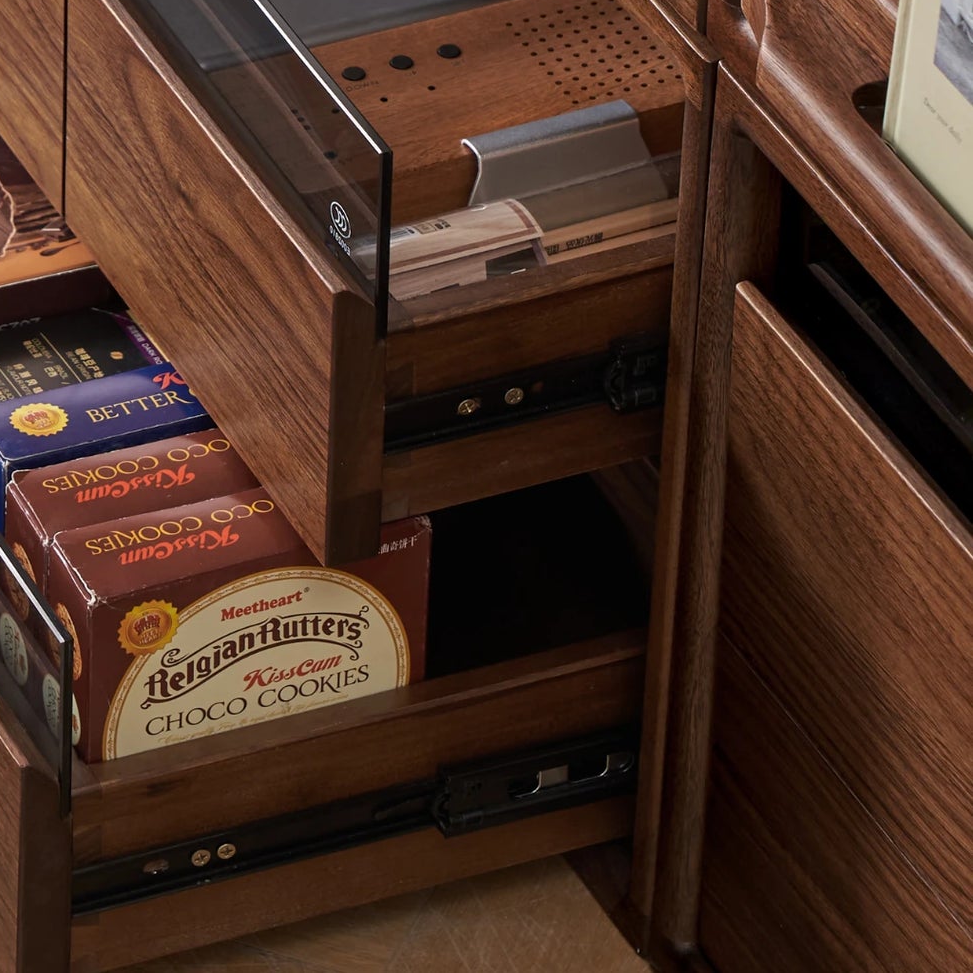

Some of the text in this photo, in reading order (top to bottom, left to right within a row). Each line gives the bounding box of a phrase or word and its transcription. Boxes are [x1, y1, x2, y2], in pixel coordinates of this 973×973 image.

[85, 390, 192, 424] BETTER
[42, 438, 231, 494] OCO COOKIES
[85, 499, 275, 556] OCO COOKIES
[145, 696, 248, 736] CHOCO
[257, 664, 370, 708] COOKIES
